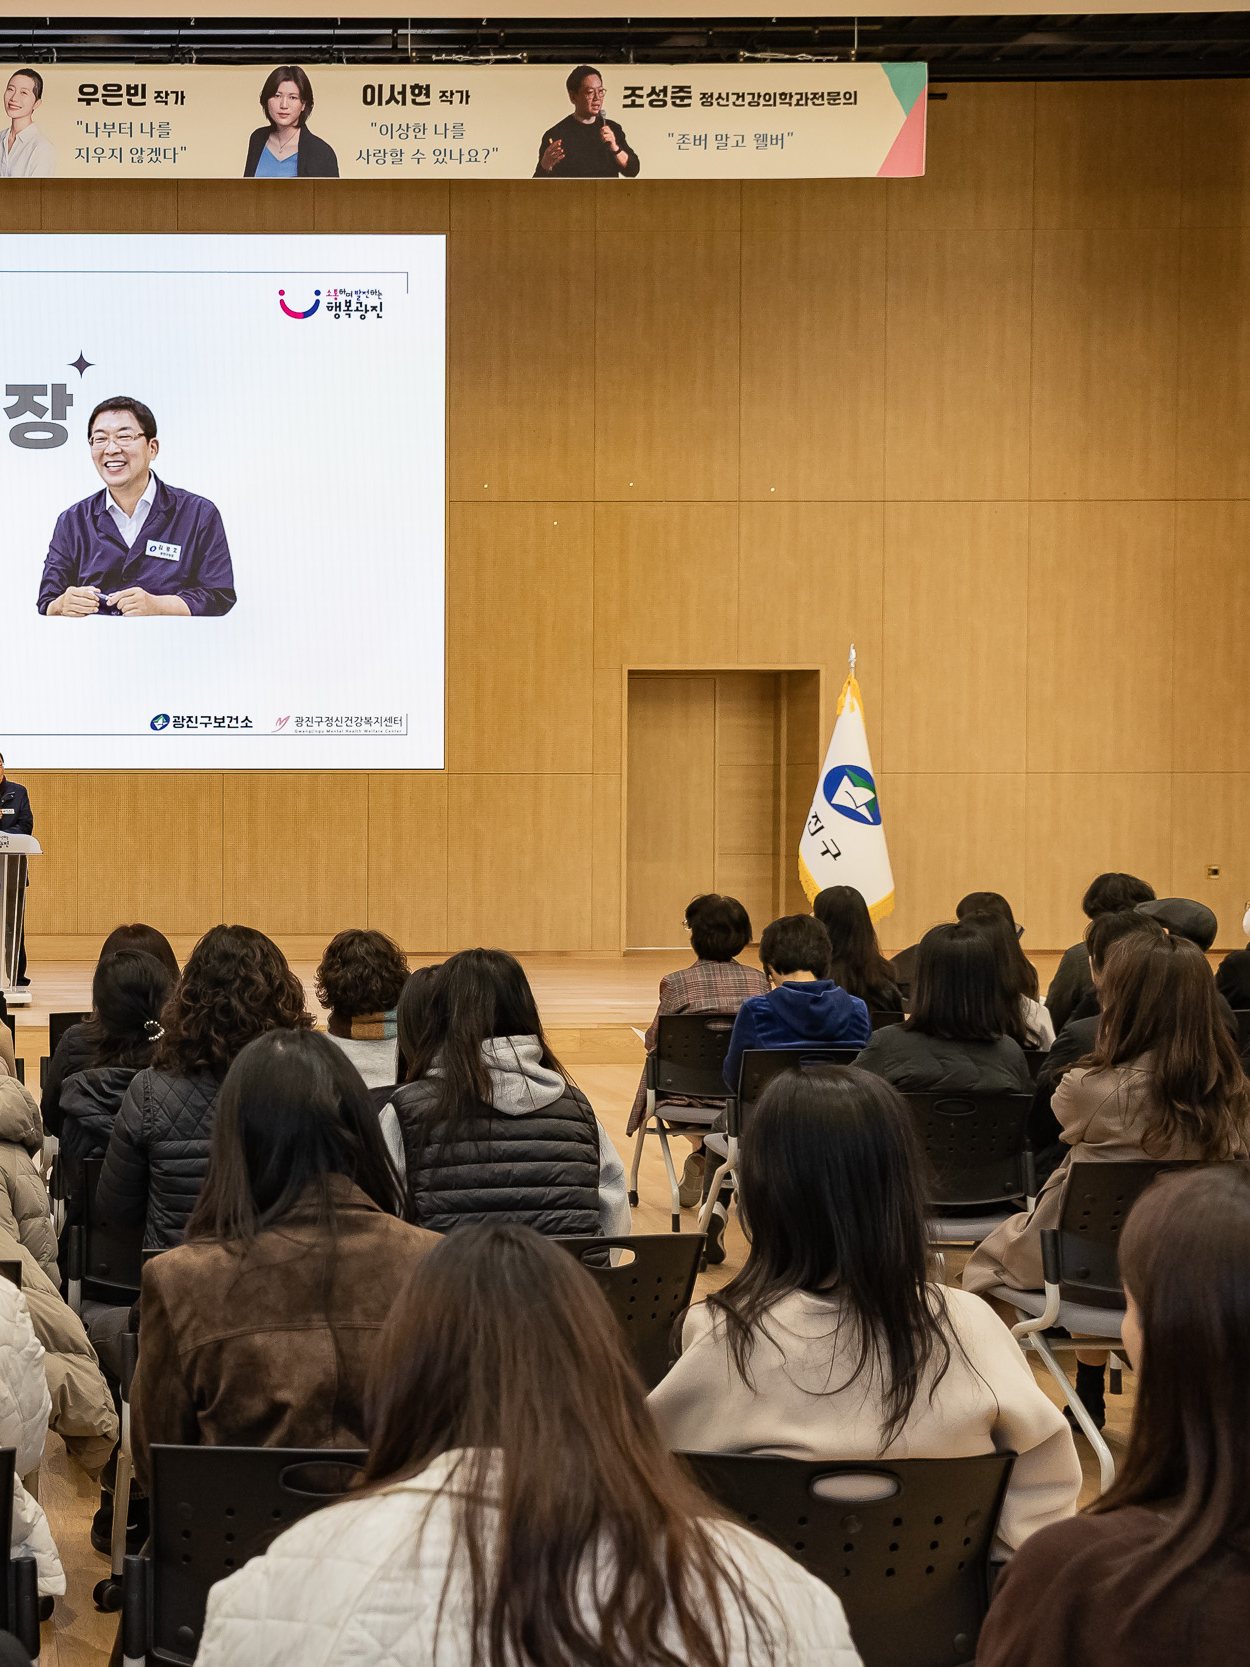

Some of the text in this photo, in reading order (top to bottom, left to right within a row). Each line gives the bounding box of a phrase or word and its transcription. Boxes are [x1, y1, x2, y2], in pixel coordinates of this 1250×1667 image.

[77, 83, 186, 107] 우은빈 작가
[362, 82, 471, 107] 이서현 작가
[622, 85, 858, 109] 조성준 정신건강의학과전문의
[76, 120, 170, 139] "나부터 나를
[370, 122, 464, 141] "이상한 나를
[667, 132, 708, 151] "존버
[714, 133, 745, 151] 말고
[75, 146, 187, 164] 지우지 않겠다"
[355, 147, 499, 166] 사랑할 수 있나요?"
[325, 299, 383, 320] 행복광진
[172, 715, 253, 729] 광진구보건소
[295, 716, 403, 728] 광진구정신건강복지센터
